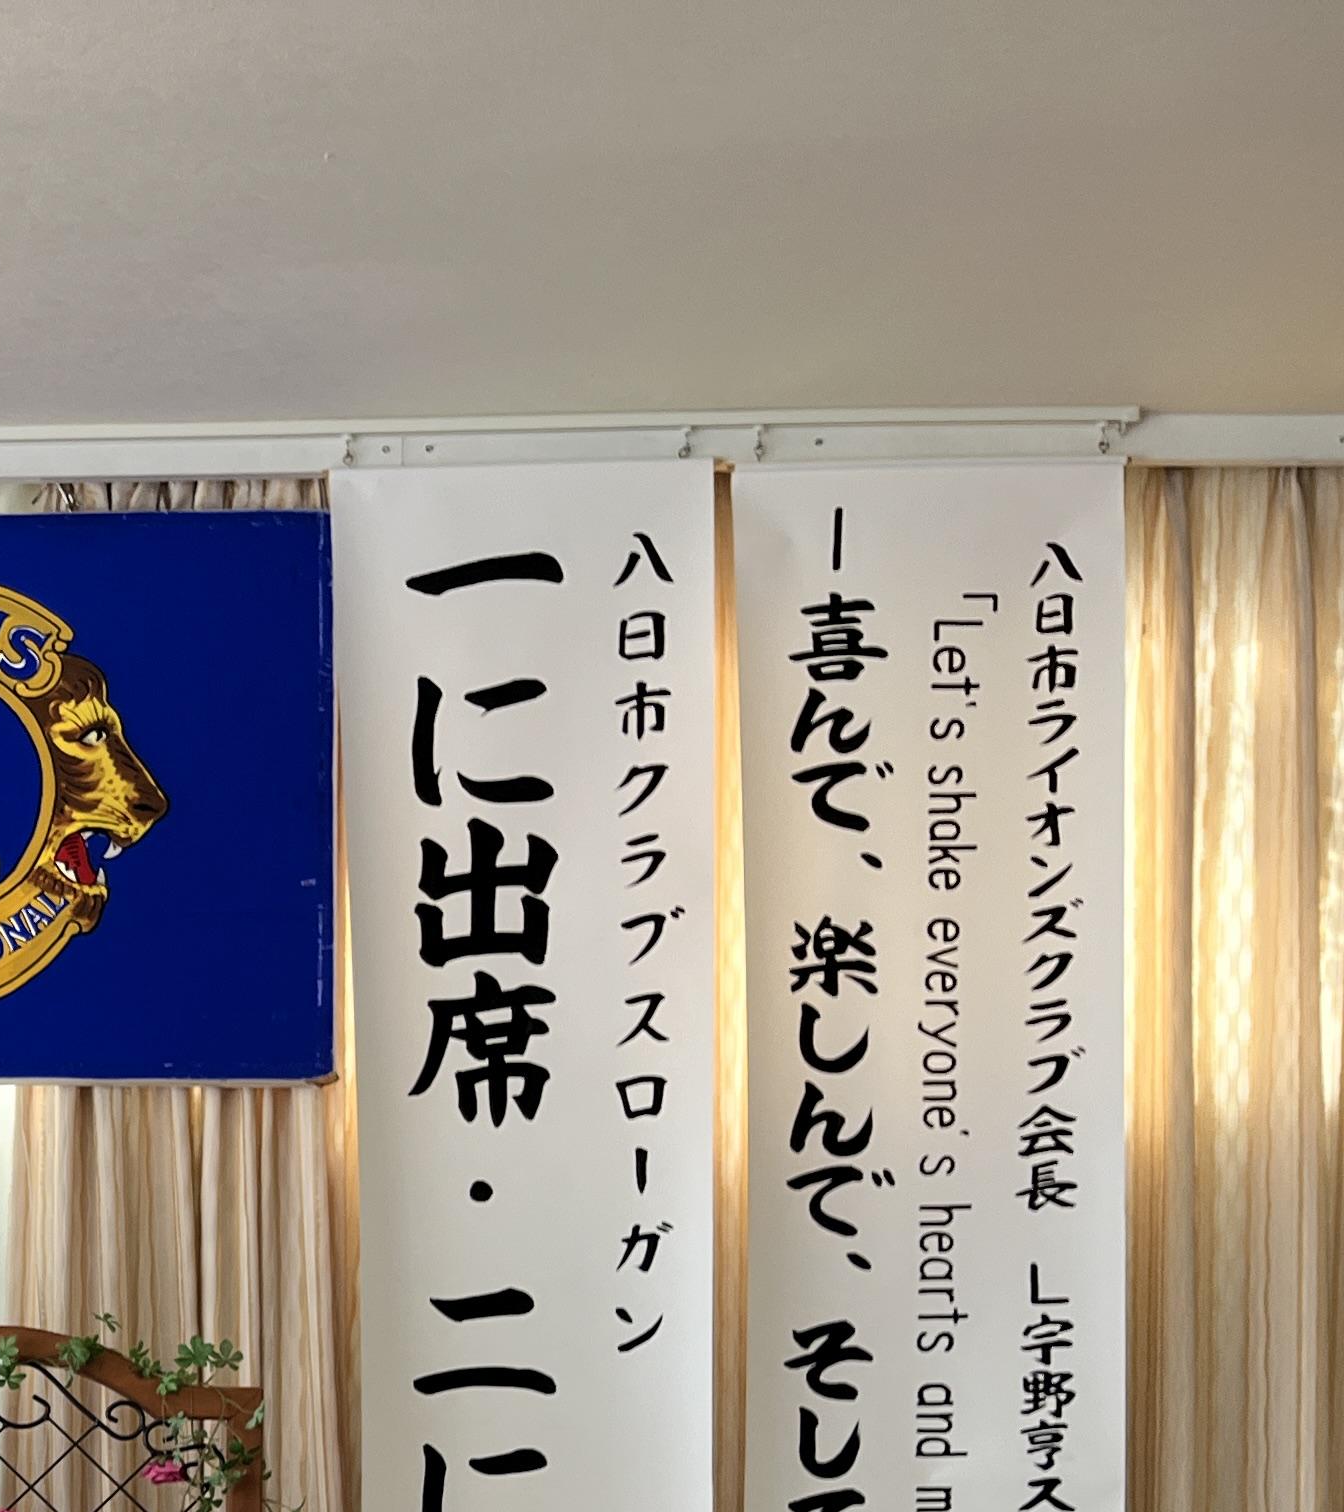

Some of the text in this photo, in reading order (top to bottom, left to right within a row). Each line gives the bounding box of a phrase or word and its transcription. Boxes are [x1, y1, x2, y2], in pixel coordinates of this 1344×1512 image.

[927, 765, 978, 891] shake
[1015, 542, 1084, 1211] 八日市ライオンズクラブ会長
[614, 532, 685, 1353] 八日市クラブスローガン
[917, 918, 970, 1177] everyone's
[916, 1204, 972, 1353] hearts
[915, 1383, 968, 1458] and
